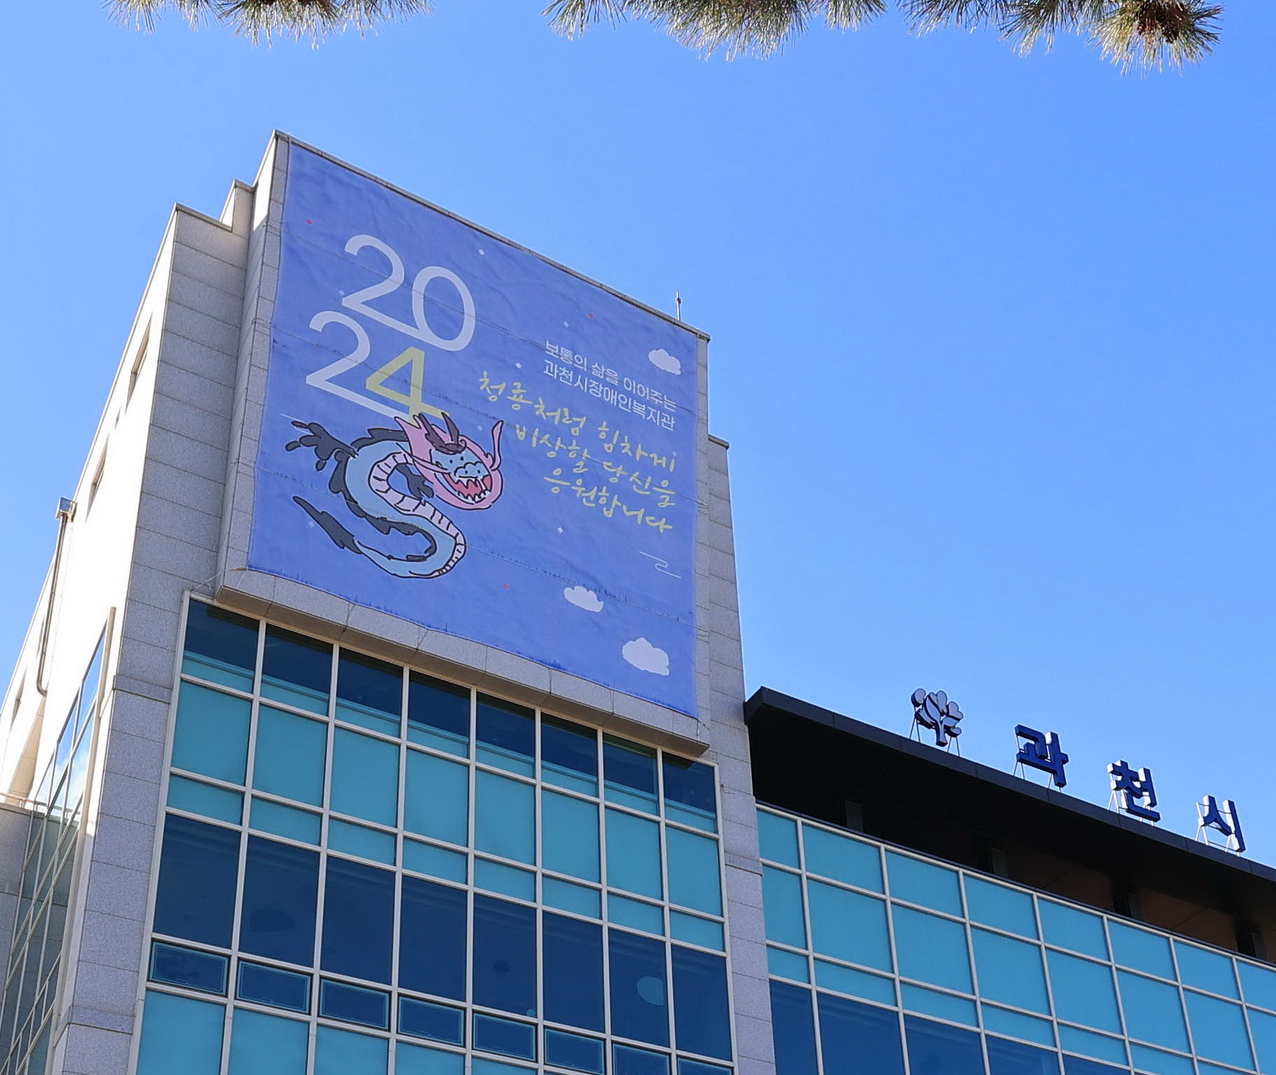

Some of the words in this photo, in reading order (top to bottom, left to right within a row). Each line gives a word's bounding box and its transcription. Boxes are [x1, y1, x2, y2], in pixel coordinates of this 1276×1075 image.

[341, 234, 476, 351] 20
[305, 311, 449, 425] 24
[543, 359, 676, 431] 과천시장애인복지관
[544, 340, 587, 371] 보통의
[591, 362, 619, 386] 삶을
[623, 377, 677, 412] 이어주는
[479, 371, 587, 436] 청룡처럼
[598, 421, 676, 472] 힘차게
[515, 424, 591, 473] 비상할
[603, 461, 676, 508] 당신을
[544, 468, 673, 533] 응원합니다
[1014, 723, 1247, 853] 과천시
